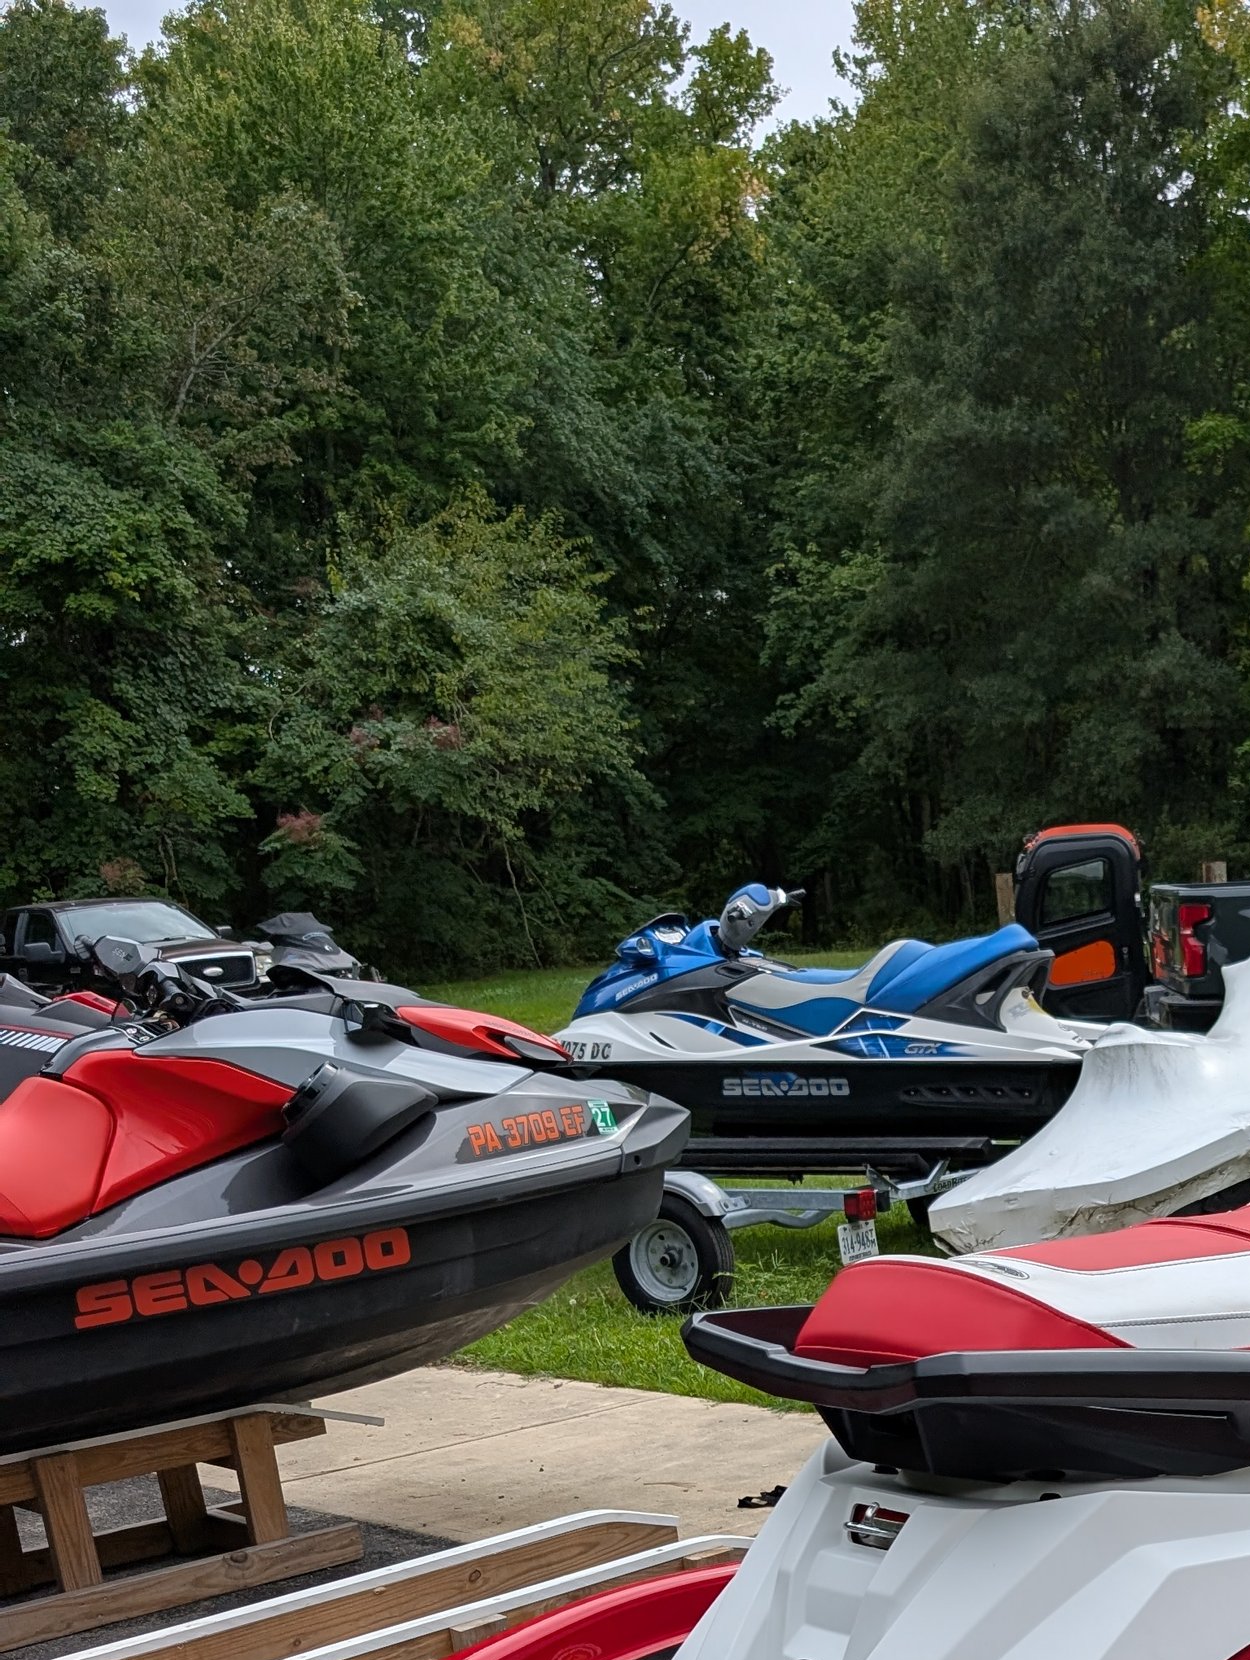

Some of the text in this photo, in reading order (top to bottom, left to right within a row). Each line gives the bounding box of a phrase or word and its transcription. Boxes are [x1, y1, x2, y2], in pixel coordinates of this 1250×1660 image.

[590, 1042, 612, 1060] DC
[904, 1042, 943, 1054] GTX
[592, 1106, 612, 1127] 27
[467, 1104, 585, 1157] PA 3709 EF
